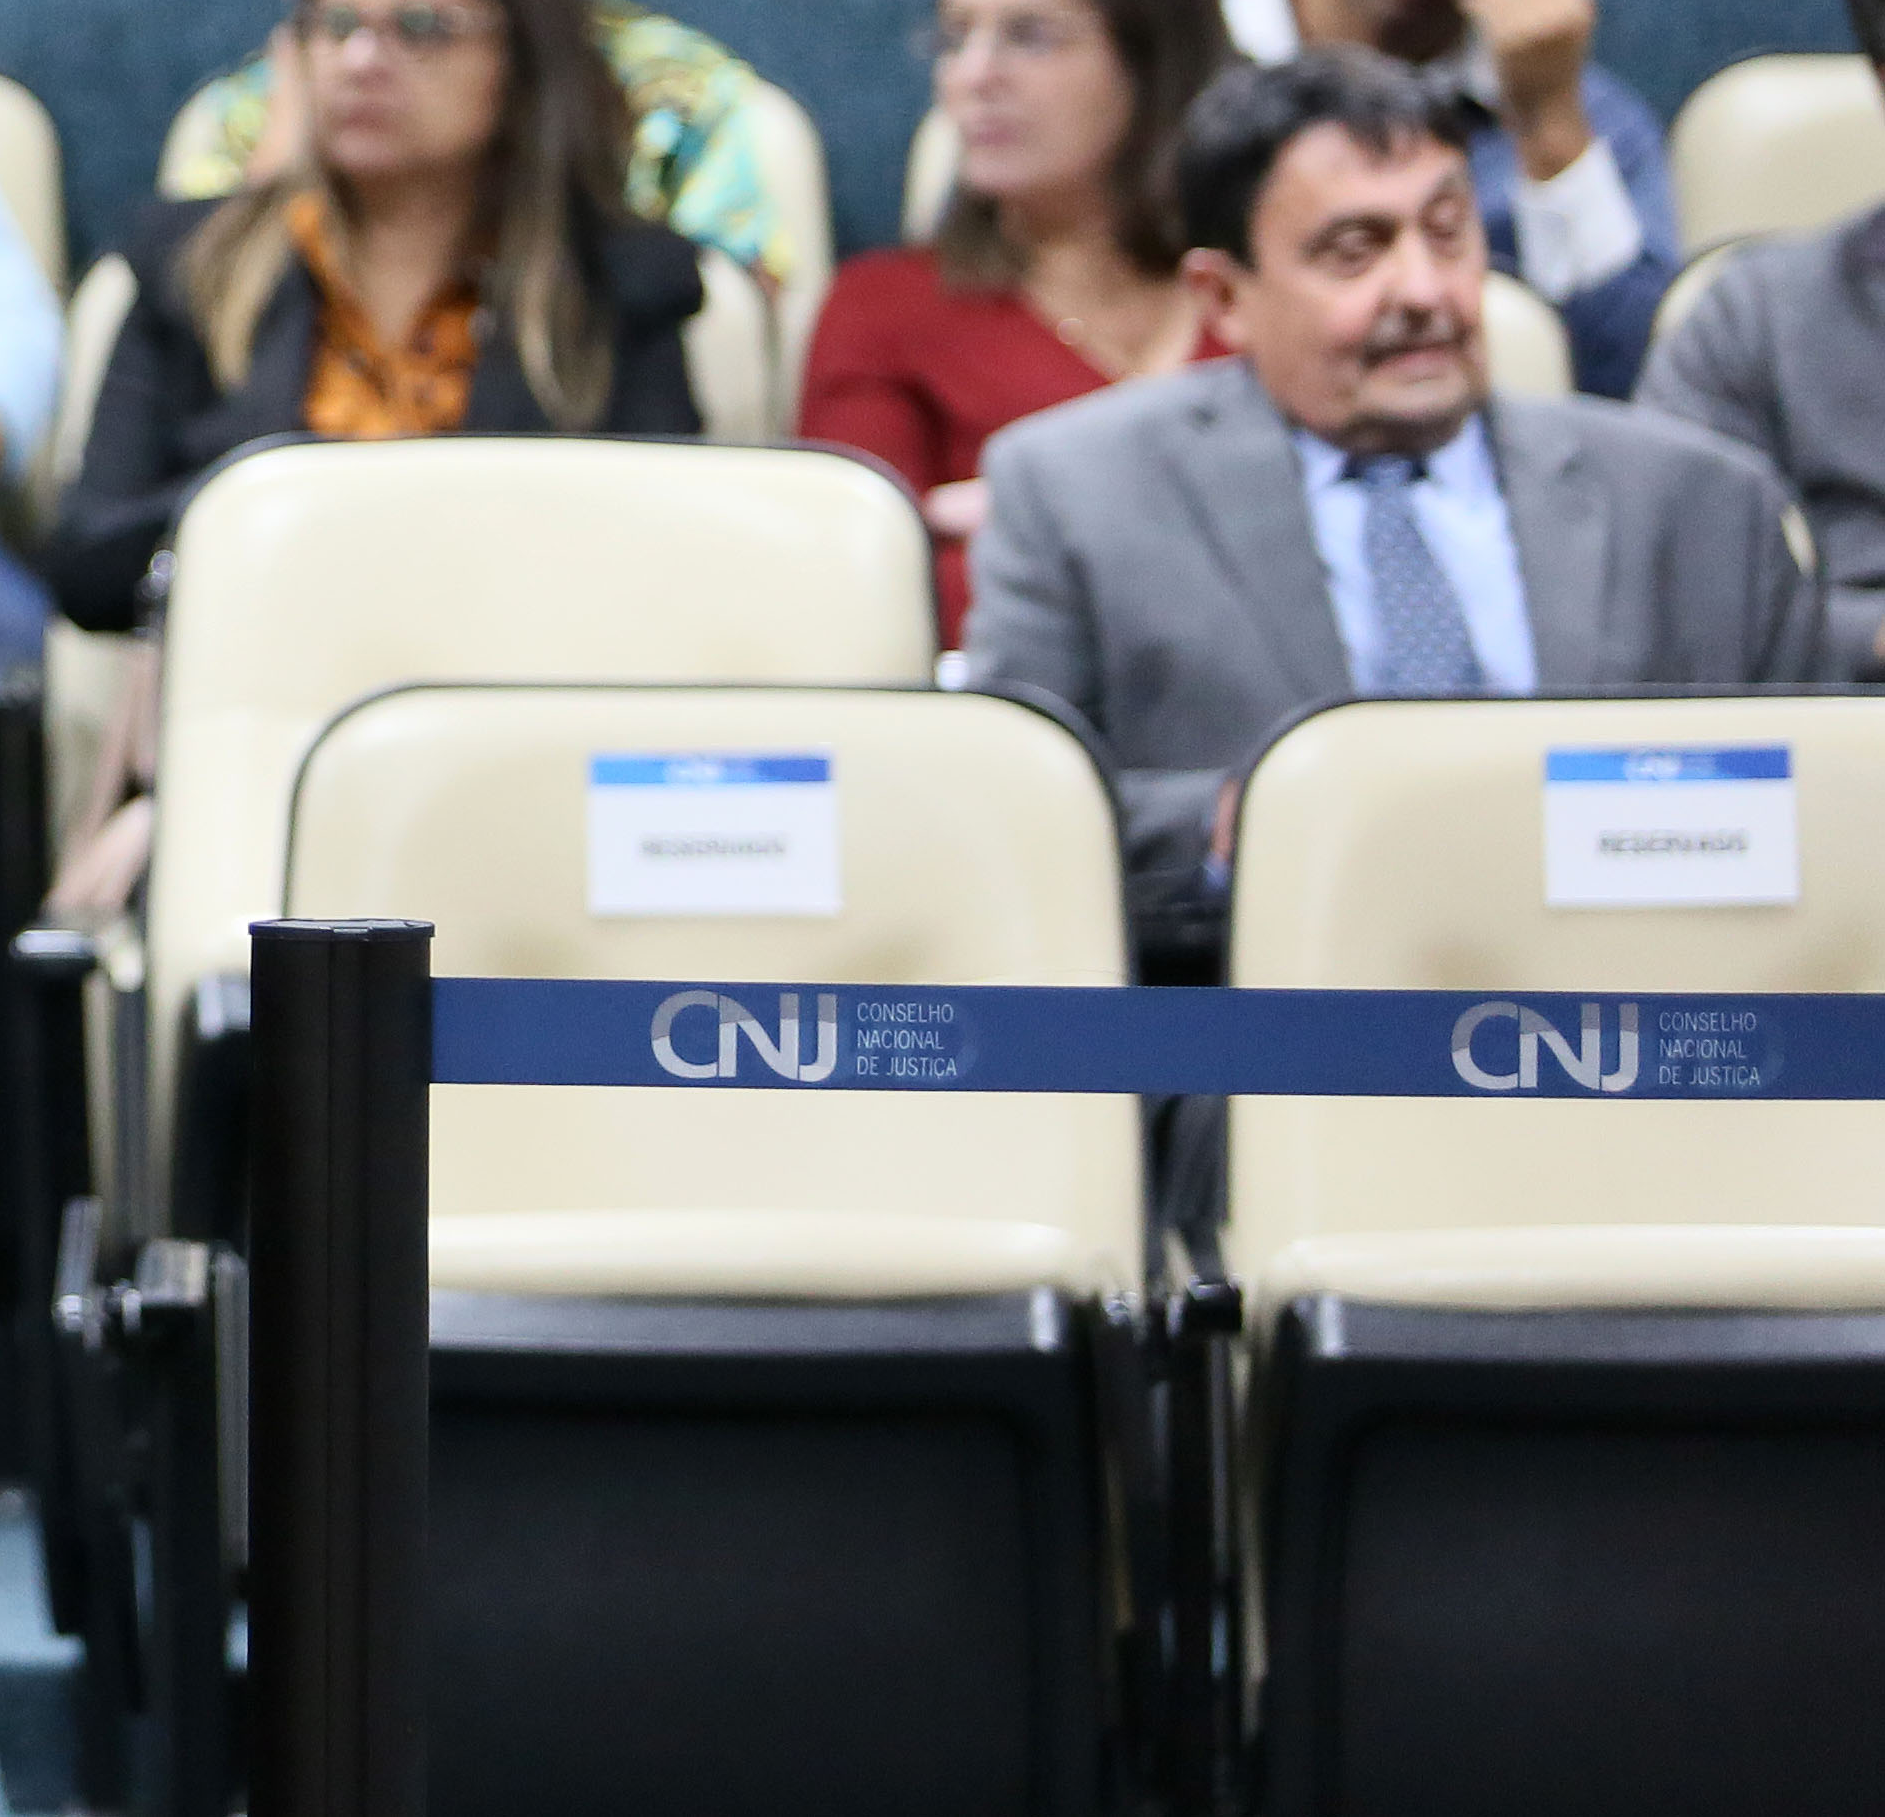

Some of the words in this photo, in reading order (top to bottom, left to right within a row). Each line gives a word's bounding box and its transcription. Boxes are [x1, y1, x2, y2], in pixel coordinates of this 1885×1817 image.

[856, 1002, 955, 1024] CONSELHO
[1658, 1011, 1758, 1032] CONSELHO
[650, 989, 838, 1082] CNJ
[856, 1029, 945, 1050] NACIONAL
[1450, 1000, 1640, 1093] CNJ
[1658, 1038, 1748, 1059] NACIONAL
[856, 1056, 880, 1076] DE
[885, 1057, 958, 1079] JUSTIÇA
[1658, 1065, 1682, 1086] DE
[1688, 1066, 1762, 1088] JUSTIÇA
